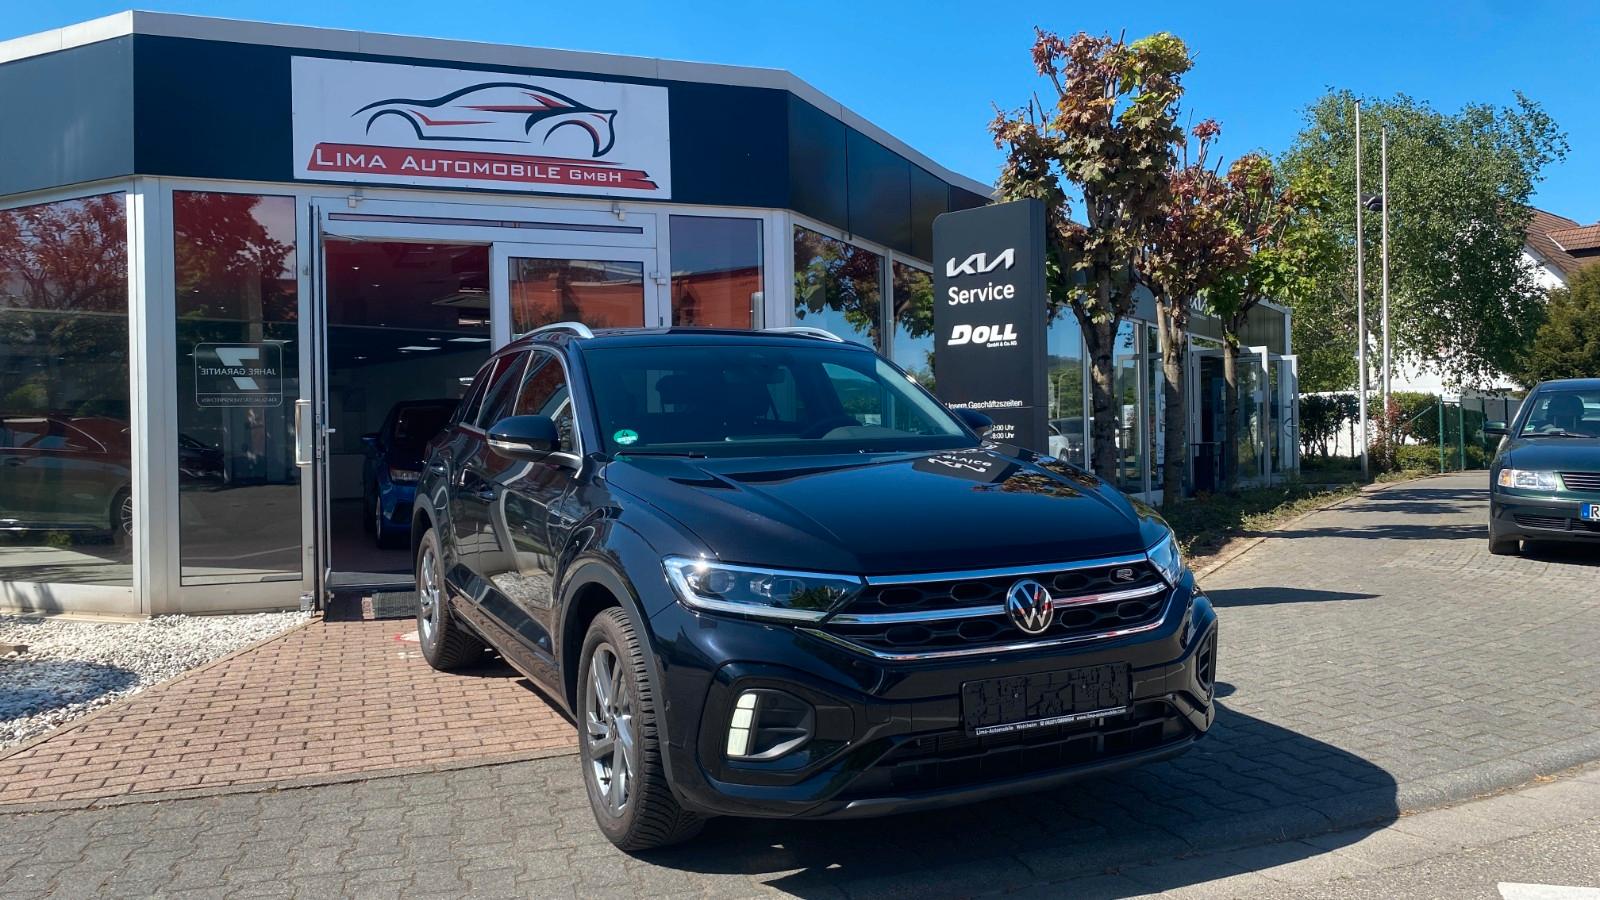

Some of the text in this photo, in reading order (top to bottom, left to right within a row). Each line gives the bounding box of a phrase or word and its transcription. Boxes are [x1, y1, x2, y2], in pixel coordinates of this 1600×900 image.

[946, 248, 1015, 277] KIA
[947, 281, 1015, 306] Service
[947, 323, 1018, 346] DOLL
